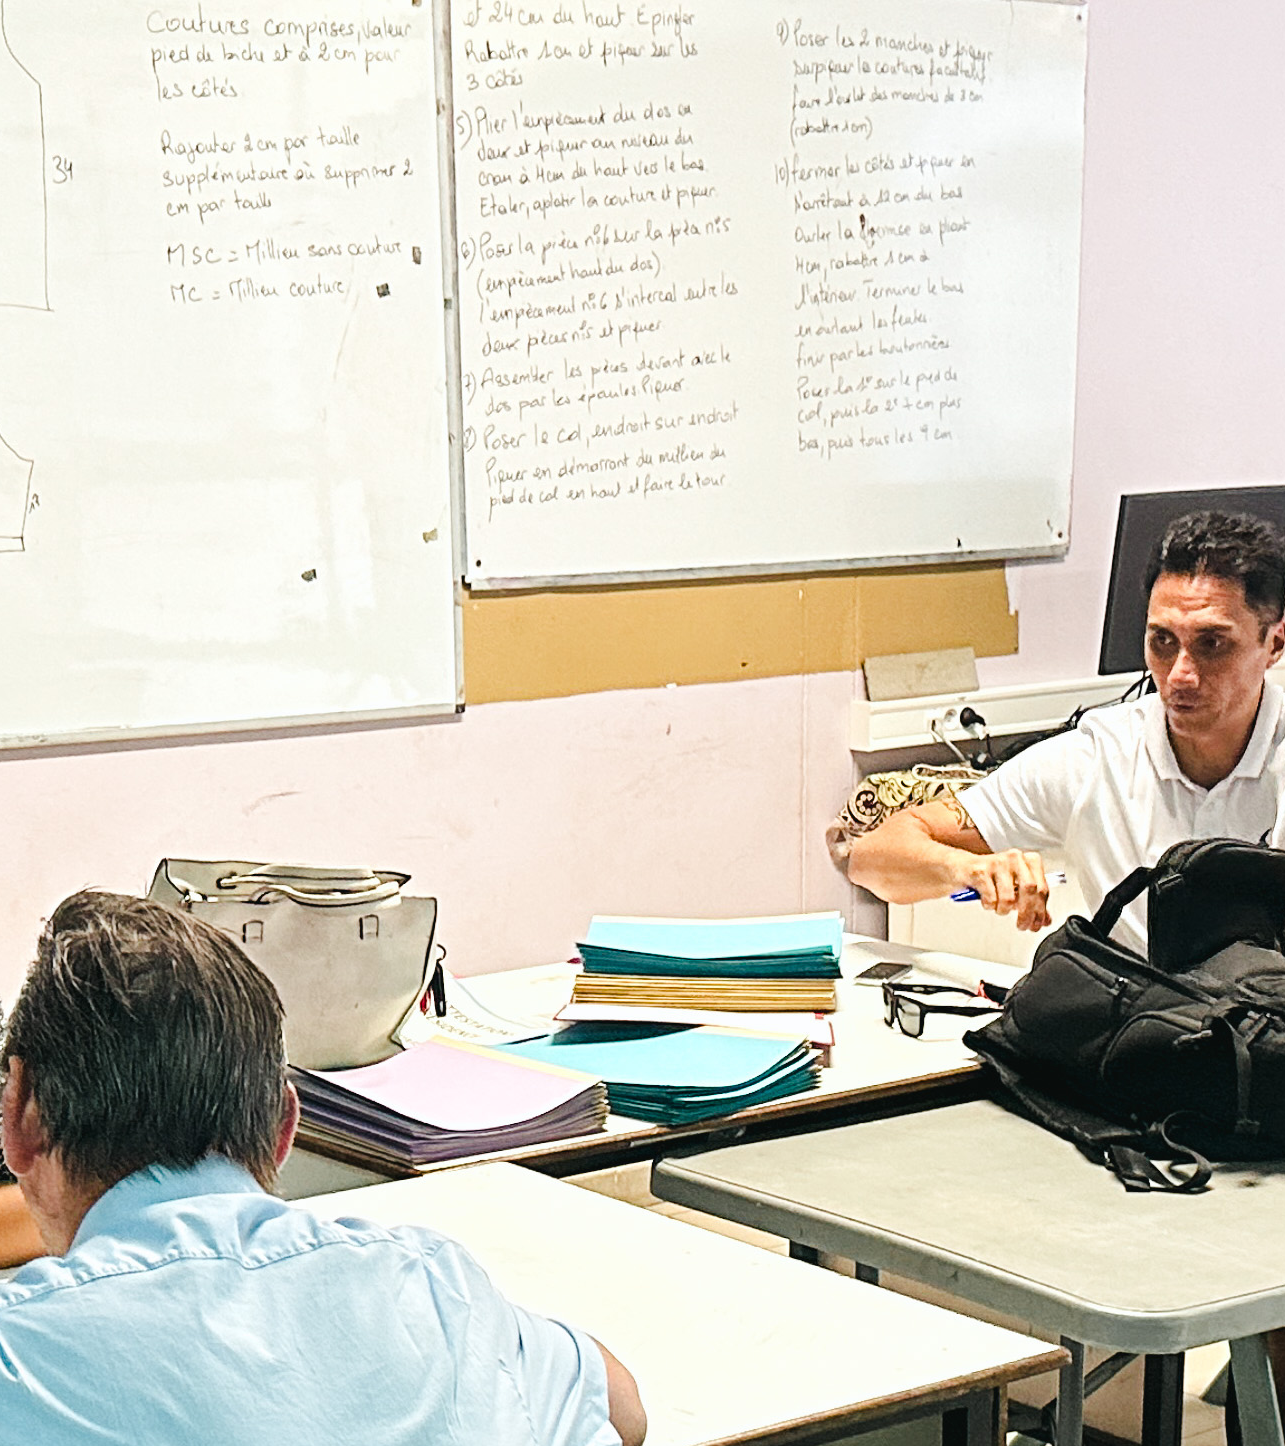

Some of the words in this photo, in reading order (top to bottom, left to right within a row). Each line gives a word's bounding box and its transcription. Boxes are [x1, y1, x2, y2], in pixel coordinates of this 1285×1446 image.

[146, 2, 250, 36] Coutures
[553, 3, 574, 24] du
[583, 0, 625, 28] haut
[273, 43, 291, 62] et
[318, 41, 333, 62] 2
[614, 102, 635, 123] du
[643, 102, 671, 121] dos
[308, 244, 343, 259] sans
[655, 415, 683, 430] sur
